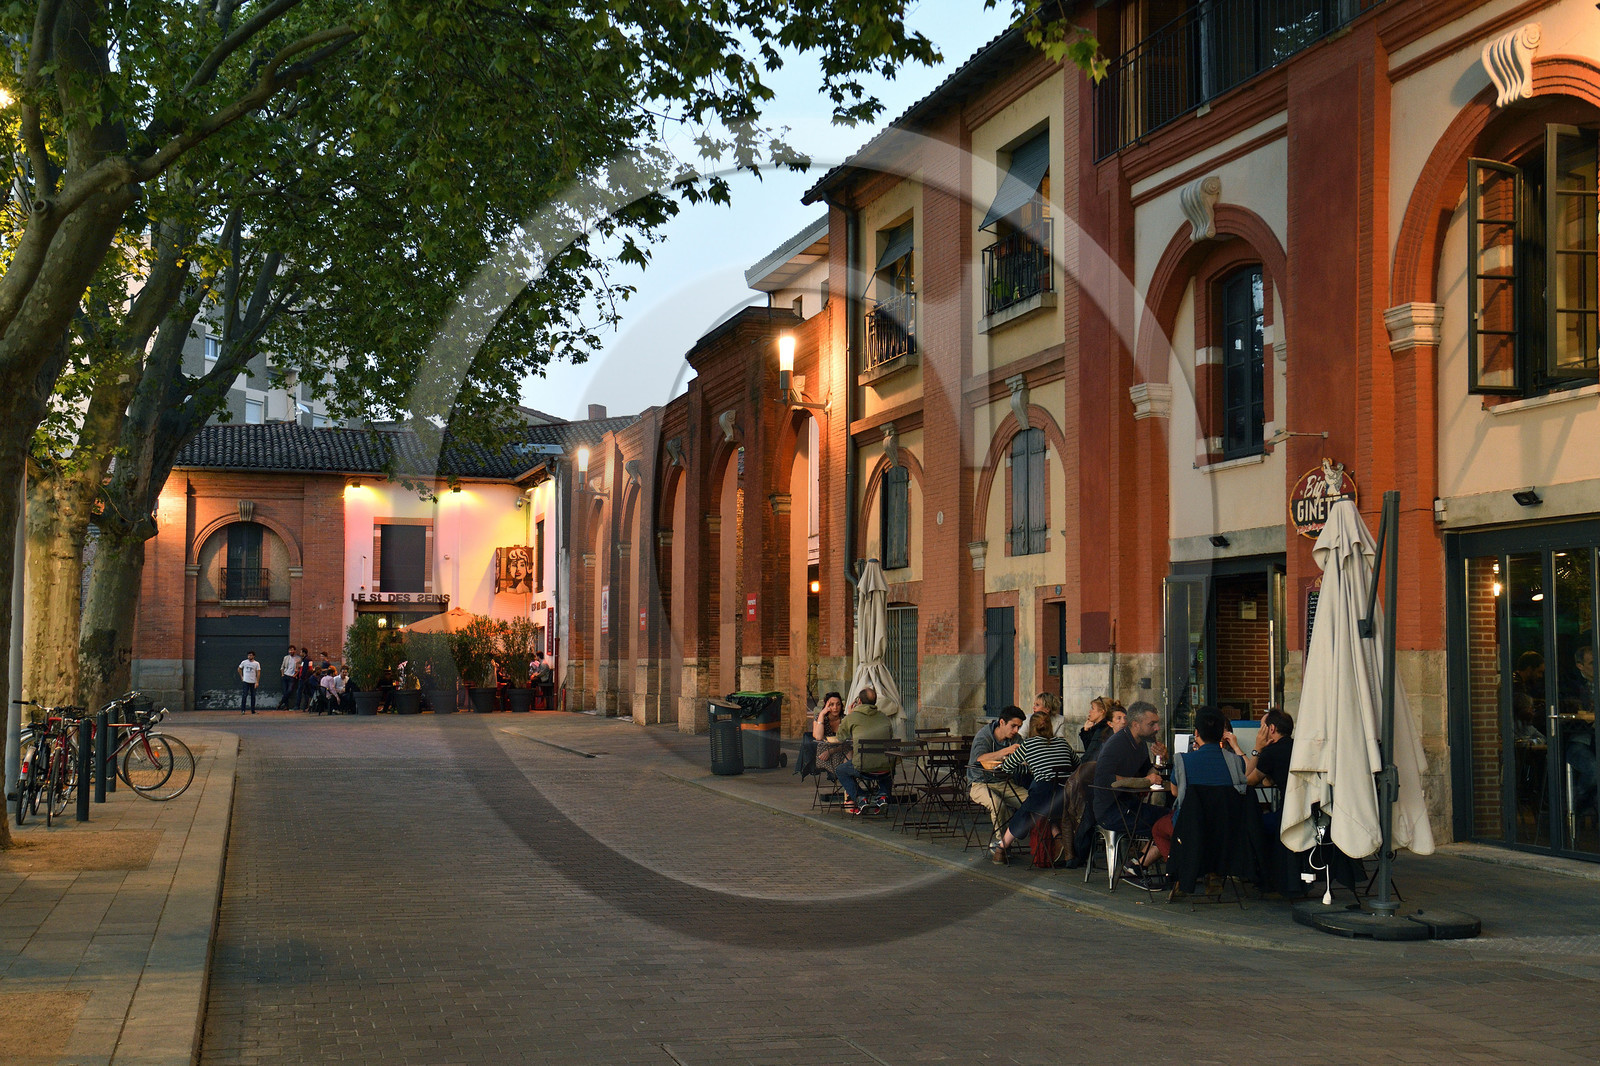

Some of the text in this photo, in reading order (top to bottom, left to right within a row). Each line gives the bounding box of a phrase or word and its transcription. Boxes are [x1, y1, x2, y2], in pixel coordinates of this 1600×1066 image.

[1304, 475, 1327, 506] Big
[1297, 494, 1349, 522] GINET
[351, 593, 366, 602] LE
[369, 593, 382, 603] St
[388, 594, 411, 603] DES
